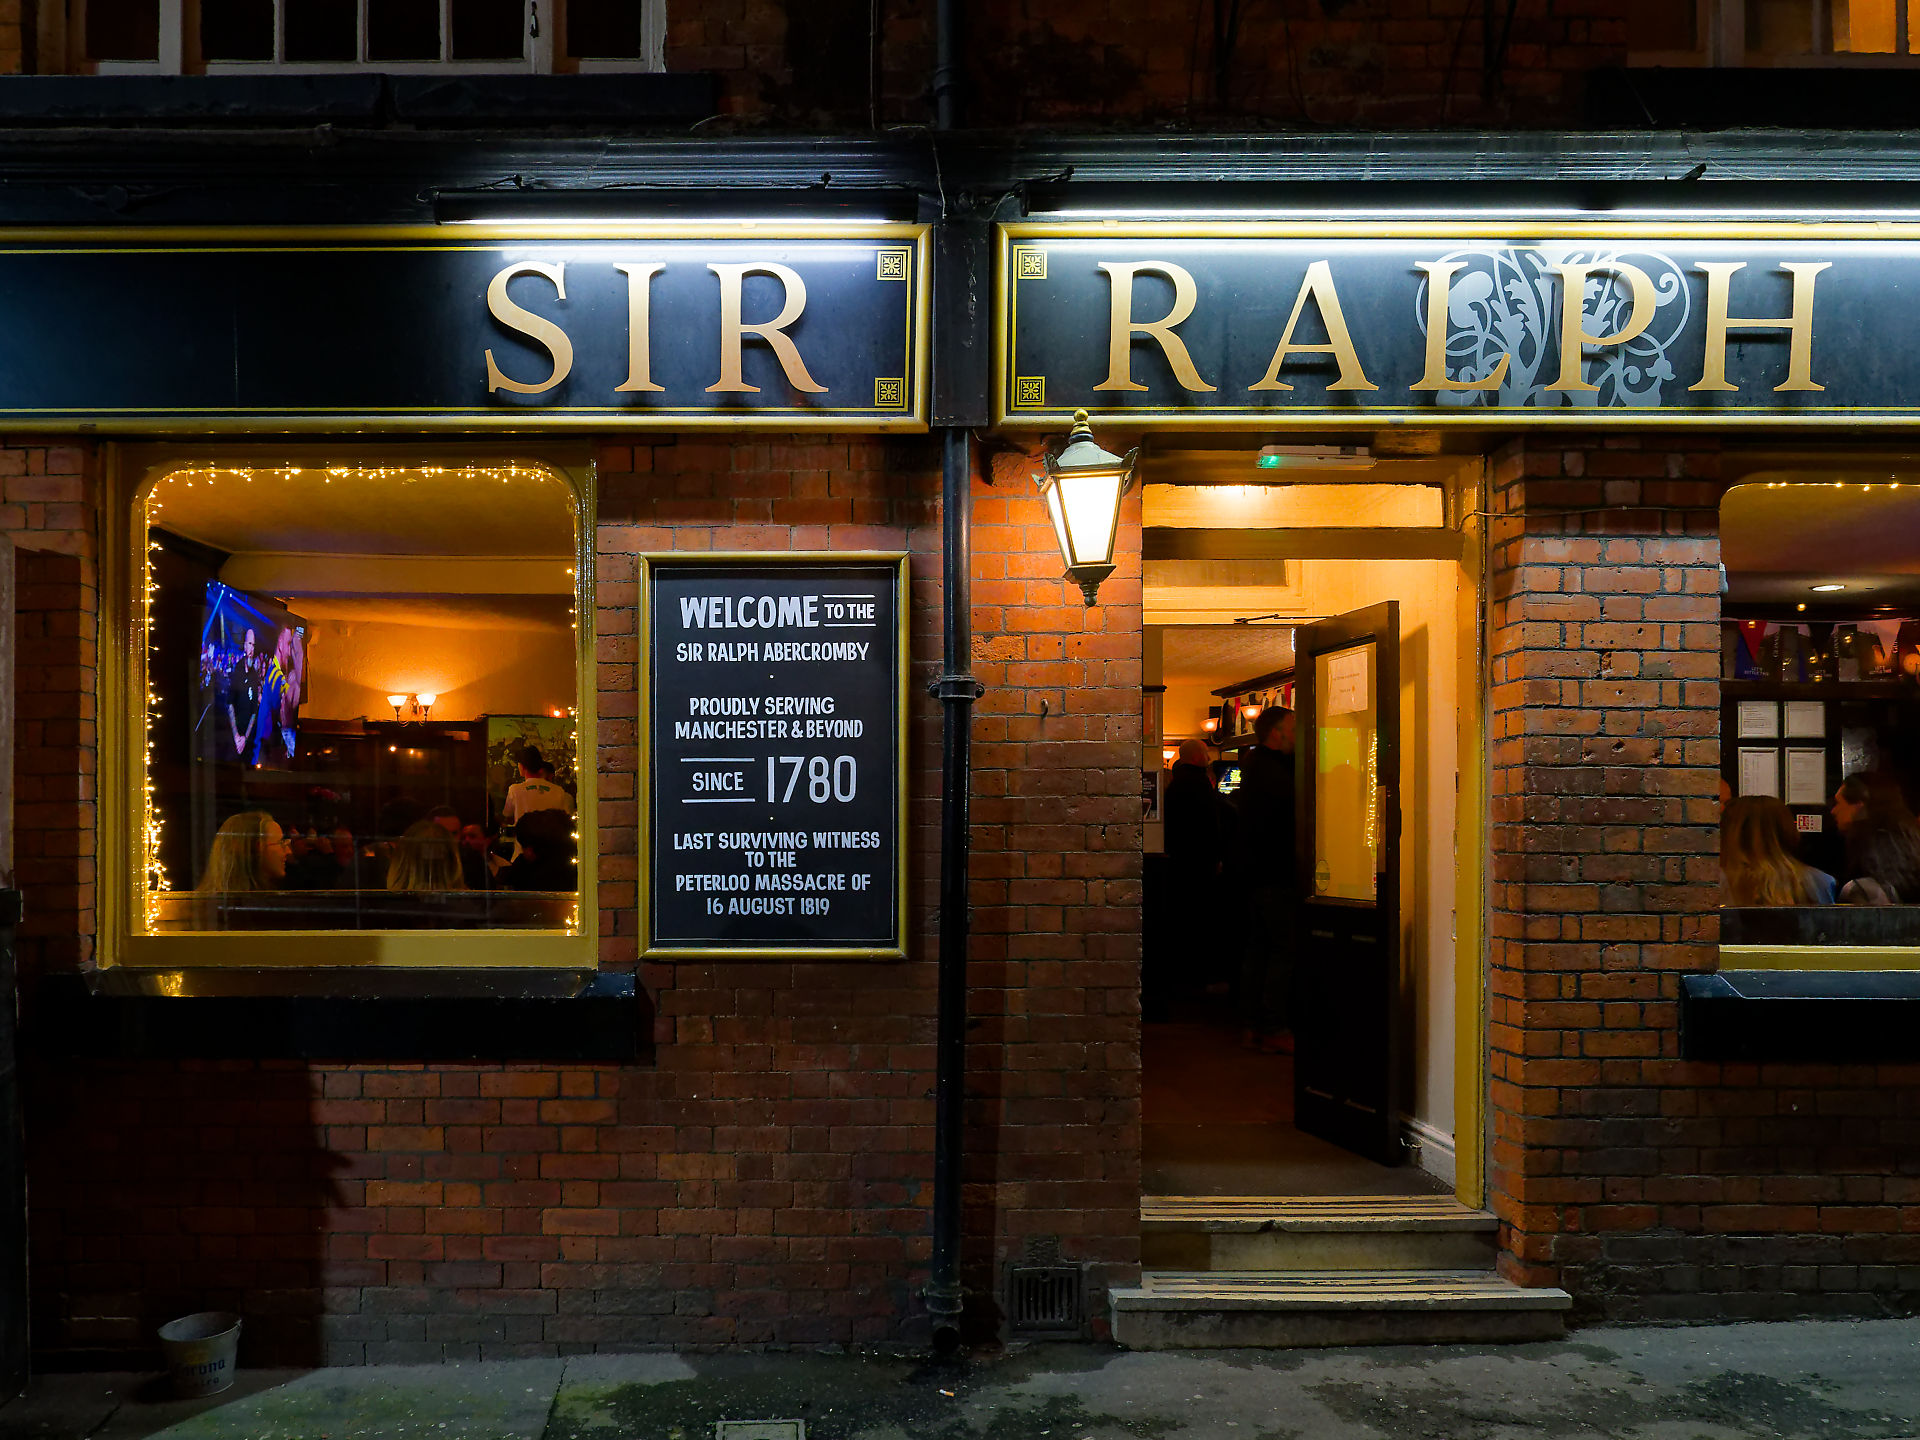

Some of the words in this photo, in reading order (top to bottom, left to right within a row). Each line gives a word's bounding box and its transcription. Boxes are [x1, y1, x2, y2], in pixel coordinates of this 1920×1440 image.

[484, 260, 829, 393] SIR
[1093, 259, 1833, 394] RALPH
[680, 596, 819, 628] WELCOME
[824, 604, 844, 619] TO
[847, 604, 875, 619] THE
[677, 643, 702, 661] SIR
[708, 643, 758, 661] RALPH
[764, 642, 869, 661] ABERCROMBY
[690, 698, 760, 715] PROUDLY
[765, 697, 834, 715] SERVING
[675, 720, 787, 739] MANCHESTER
[791, 720, 803, 738] &
[806, 720, 863, 738] BEYOND
[693, 772, 743, 791] SINCE
[768, 756, 856, 803] 1780
[674, 833, 714, 849] LAST
[719, 832, 807, 849] SURVIVING
[813, 832, 880, 848] WITNESS
[745, 852, 764, 867] TO
[768, 852, 796, 867] THE
[676, 875, 749, 891] PETERLOO
[755, 874, 845, 890] MASSACRE
[852, 874, 870, 890] OF
[707, 898, 723, 914] 16
[729, 898, 795, 915] AUGUST
[801, 898, 829, 915] 1819
